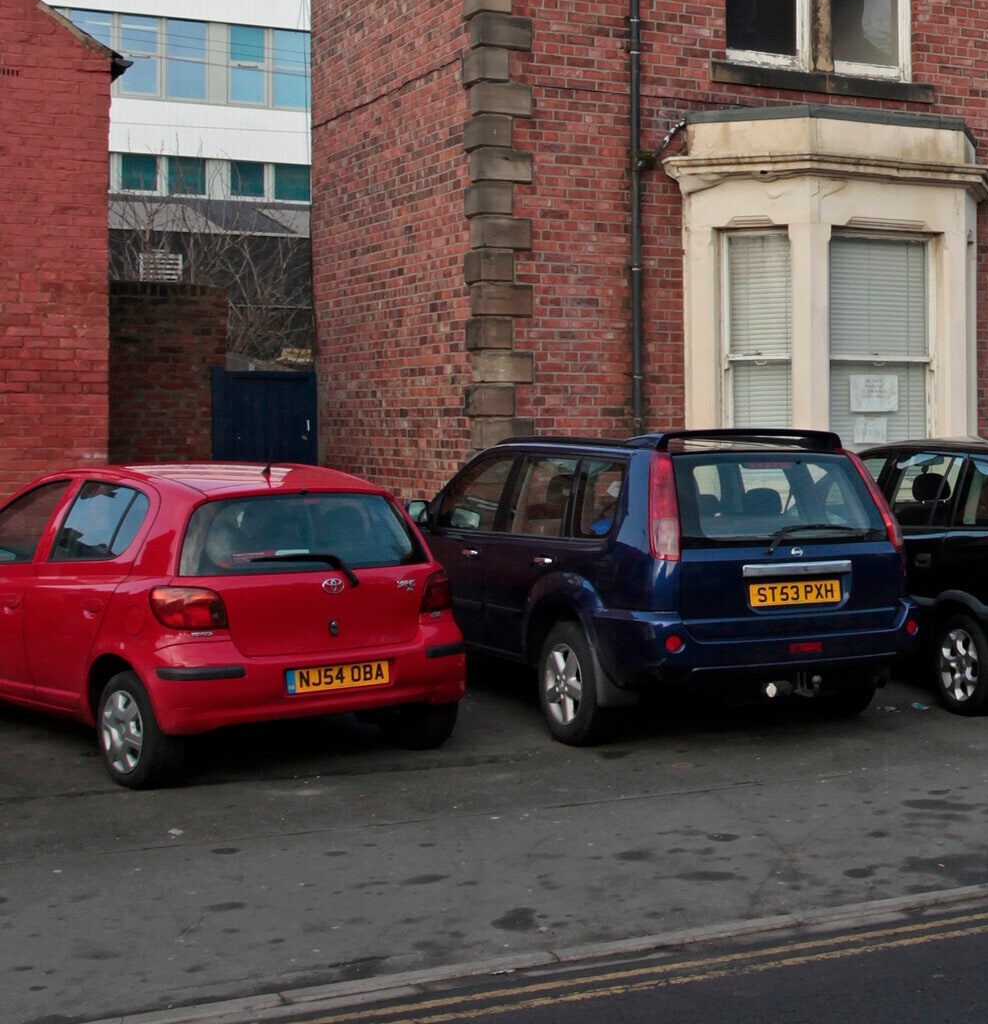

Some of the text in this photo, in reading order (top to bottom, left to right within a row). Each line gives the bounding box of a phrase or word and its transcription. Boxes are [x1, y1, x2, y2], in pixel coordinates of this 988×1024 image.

[757, 583, 835, 603] ST53 PXH
[299, 663, 384, 688] NJ54 OBA
